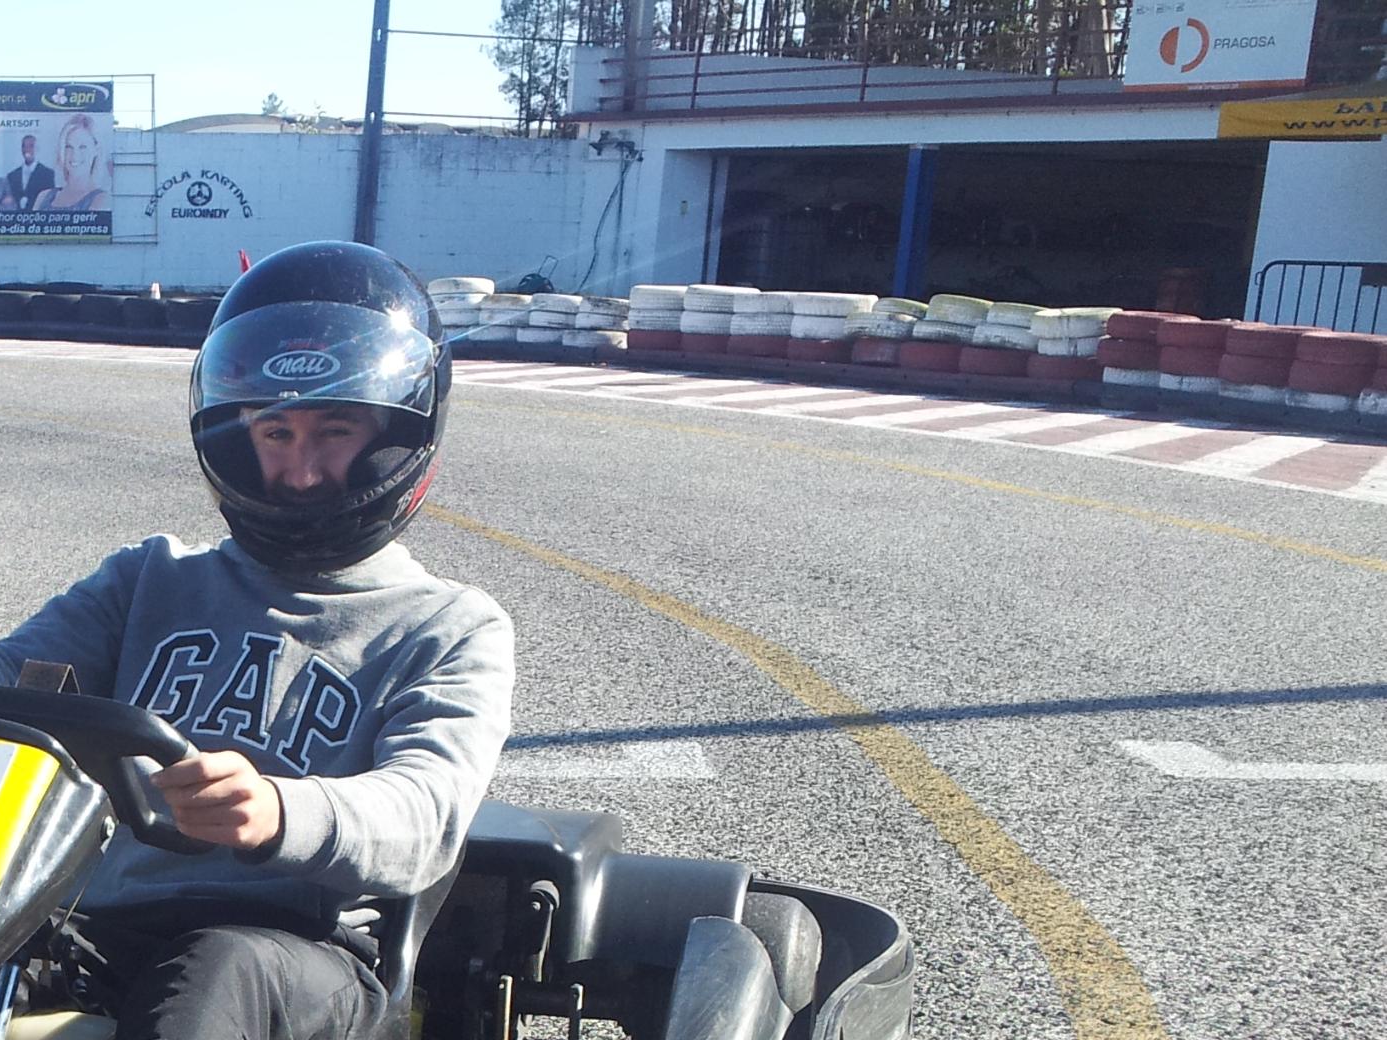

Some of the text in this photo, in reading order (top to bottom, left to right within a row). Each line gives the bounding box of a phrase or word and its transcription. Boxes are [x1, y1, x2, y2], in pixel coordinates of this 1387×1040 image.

[1214, 36, 1276, 49] PRAGOSA
[69, 90, 96, 105] apri
[0, 119, 40, 128] ARTSOFT
[144, 169, 253, 219] ESCOLA KARTING
[16, 212, 46, 223] opção
[48, 213, 71, 223] para
[73, 212, 98, 223] gerir
[171, 207, 230, 219] EUROINDY
[28, 224, 41, 233] da
[43, 225, 62, 233] sua
[64, 225, 109, 235] empresa
[130, 628, 362, 776] GAP
